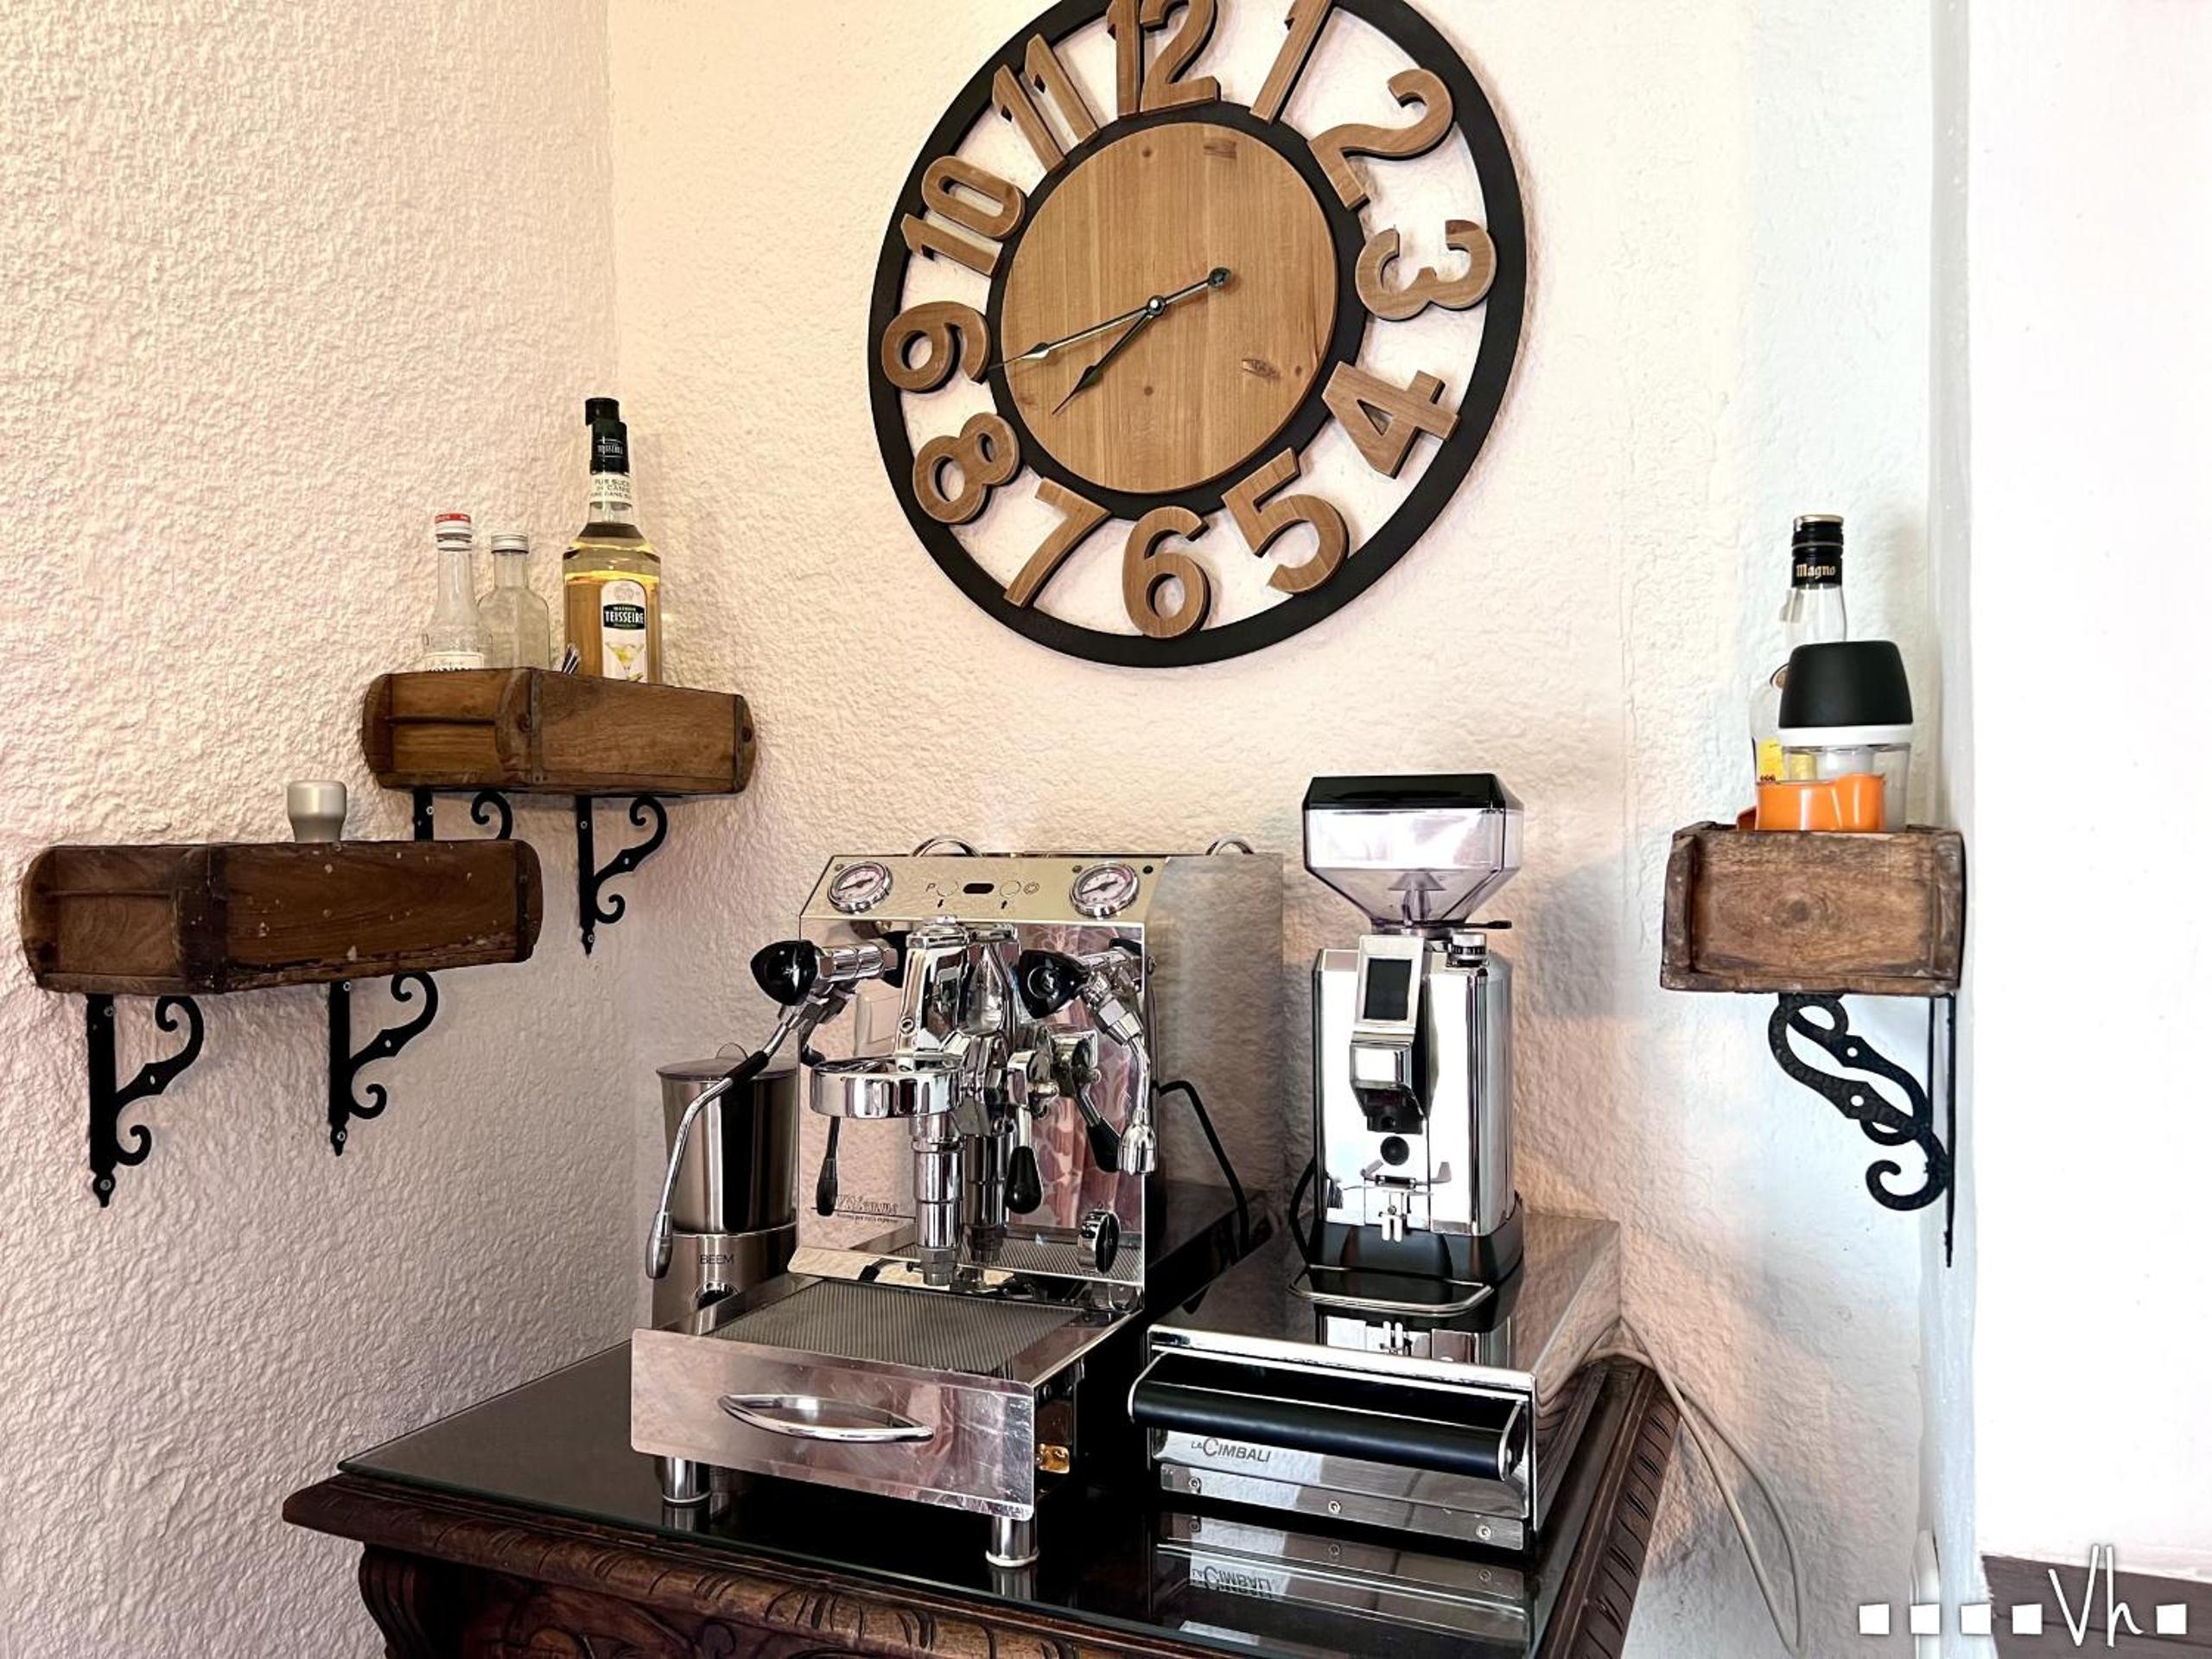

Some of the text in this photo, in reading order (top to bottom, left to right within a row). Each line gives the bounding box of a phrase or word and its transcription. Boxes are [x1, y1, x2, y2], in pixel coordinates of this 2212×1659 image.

[992, 33, 1100, 174] 11
[1107, 0, 1221, 119] 12
[1249, 0, 1334, 124] 1
[1307, 67, 1454, 210] 2
[900, 156, 1027, 278] 10
[1355, 219, 1497, 321] 3
[881, 300, 991, 392] 9
[912, 411, 1020, 524] 8
[1321, 360, 1461, 479] 4
[1003, 477, 1111, 609] 7
[1122, 505, 1211, 639] 6
[1221, 447, 1350, 594] 5
[1796, 563, 1836, 580] Magno
[605, 610, 644, 624] TEISSEIRE
[700, 1254, 734, 1264] BEEM
